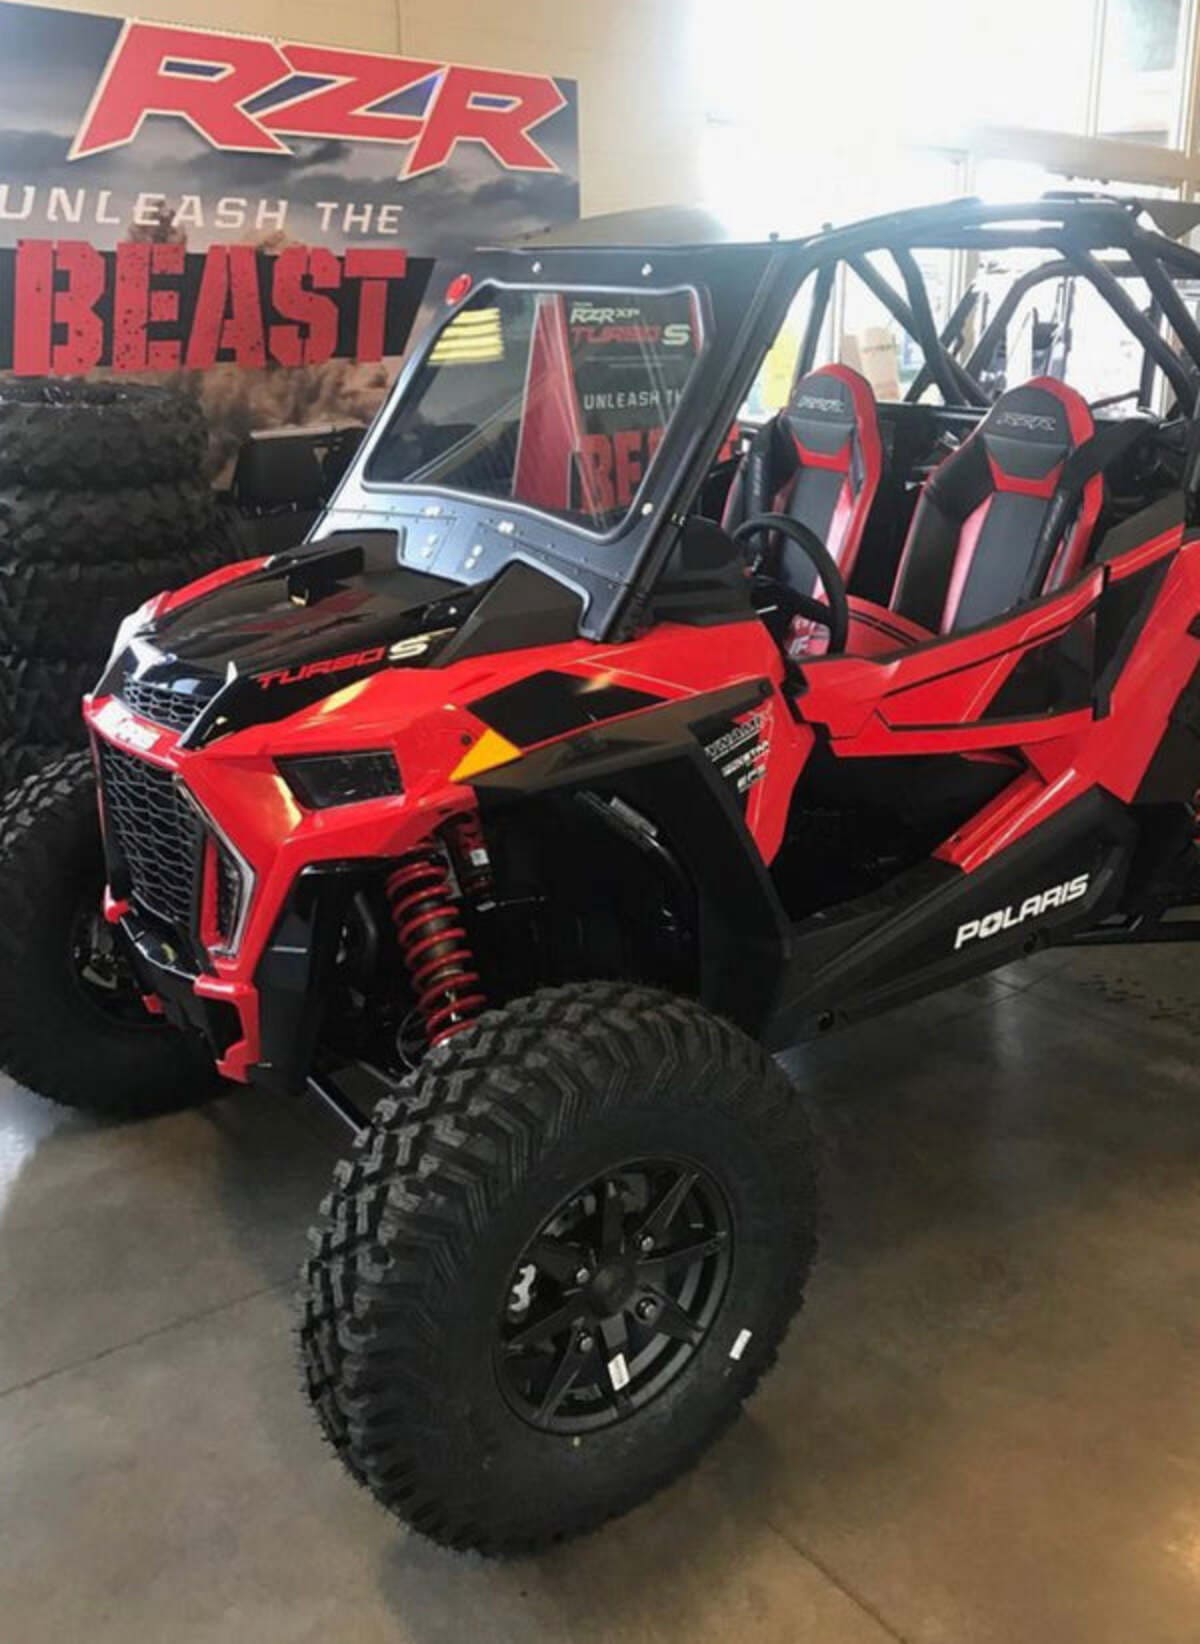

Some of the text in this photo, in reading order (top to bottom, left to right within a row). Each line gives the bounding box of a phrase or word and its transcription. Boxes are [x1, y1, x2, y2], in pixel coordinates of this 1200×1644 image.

[67, 15, 568, 181] RZR
[0, 184, 404, 236] UNLEASH THE
[13, 238, 407, 377] BEAST
[569, 307, 615, 324] RZR
[661, 323, 691, 346] S
[583, 391, 660, 411] UNLEASH
[578, 424, 673, 515] BE
[257, 634, 432, 690] TURBO S
[953, 872, 1090, 950] POLARIS
